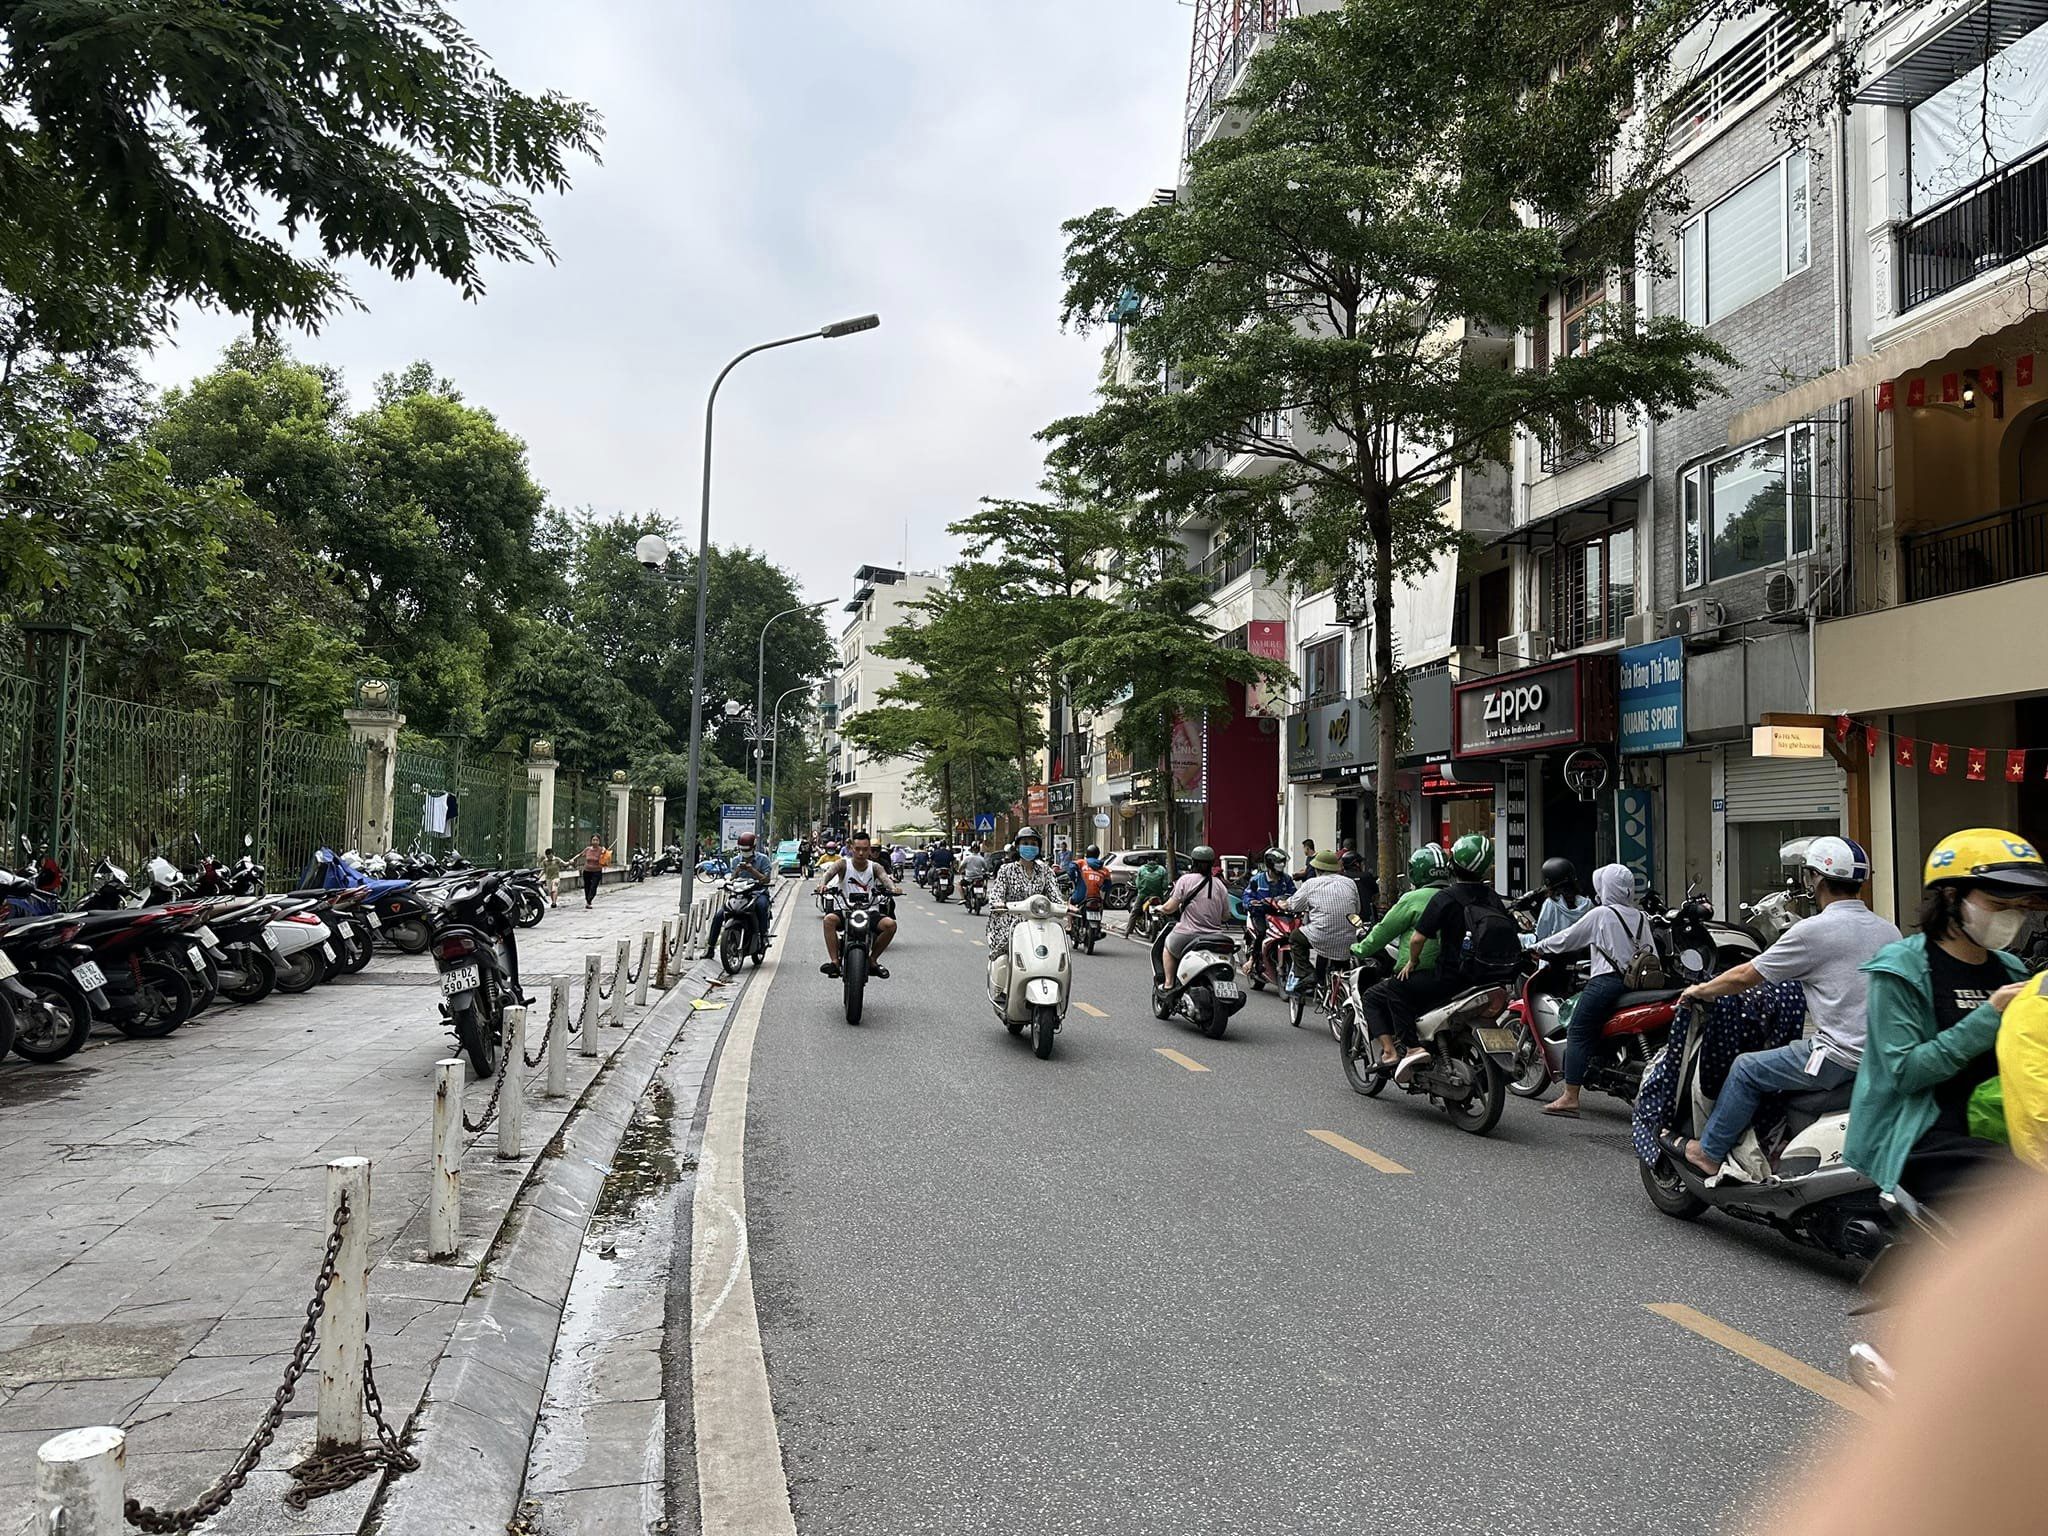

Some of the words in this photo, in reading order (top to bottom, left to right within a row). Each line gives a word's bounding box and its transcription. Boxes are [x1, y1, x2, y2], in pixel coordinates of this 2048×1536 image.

[1633, 662, 1649, 689] Hàng
[1663, 656, 1680, 682] Thao
[1623, 709, 1649, 736] QUANG
[1650, 705, 1678, 731] SPORT
[1486, 729, 1498, 738] Live
[1500, 727, 1511, 736] Life
[1511, 722, 1541, 734] Individual
[1508, 845, 1525, 858] MADE
[1429, 868, 1450, 877] Grab
[1513, 867, 1520, 880] IN
[1953, 989, 1987, 999] TELL
